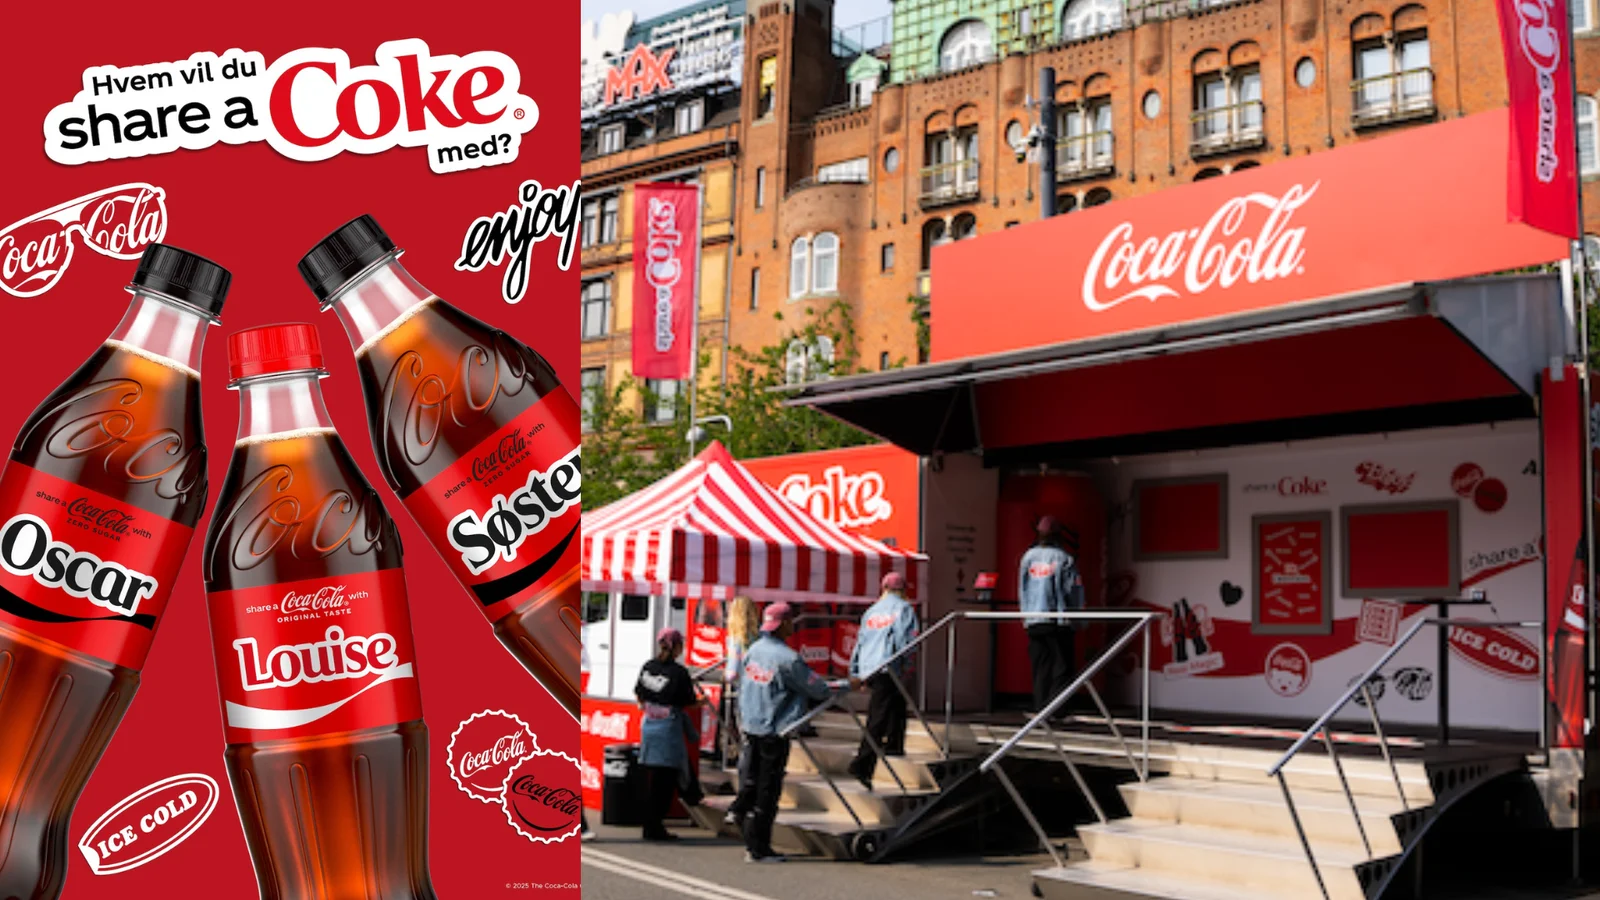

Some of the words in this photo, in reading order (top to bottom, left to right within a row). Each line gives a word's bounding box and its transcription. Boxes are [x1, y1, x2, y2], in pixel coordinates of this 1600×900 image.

[92, 70, 173, 96] Hvem
[180, 61, 214, 85] vil
[221, 57, 257, 80] du
[604, 43, 676, 106] MAX
[58, 101, 211, 150] share
[223, 96, 259, 129] a
[269, 53, 508, 148] Coke
[437, 133, 512, 163] med?
[458, 183, 581, 300] enjoy
[1082, 179, 1321, 311] Coca-Cola
[443, 481, 467, 499] share
[472, 428, 526, 482] Coca-Cola
[526, 422, 545, 438] with
[483, 470, 504, 488] ZERO
[505, 450, 531, 470] SUGAR
[1278, 476, 1327, 497] Coke
[36, 490, 60, 504] share
[67, 497, 135, 535] Coca-Cola
[132, 527, 152, 539] with
[66, 518, 89, 530] ZERO
[92, 527, 121, 542] SUGAR
[2, 519, 153, 611] Oscar
[1469, 549, 1519, 571] share
[1523, 543, 1537, 556] a
[246, 604, 271, 614] share
[281, 584, 348, 614] Coca-Cola
[348, 591, 369, 600] with
[277, 613, 321, 623] ORIGINAL
[324, 609, 352, 618] TASTE
[236, 628, 396, 688] Louise
[1453, 627, 1483, 651] ICE
[1486, 640, 1536, 671] COLD
[460, 728, 527, 778] Coca-Cola
[512, 774, 581, 816] Coca-Cola
[97, 825, 138, 859] ICE
[140, 790, 198, 833] COLD
